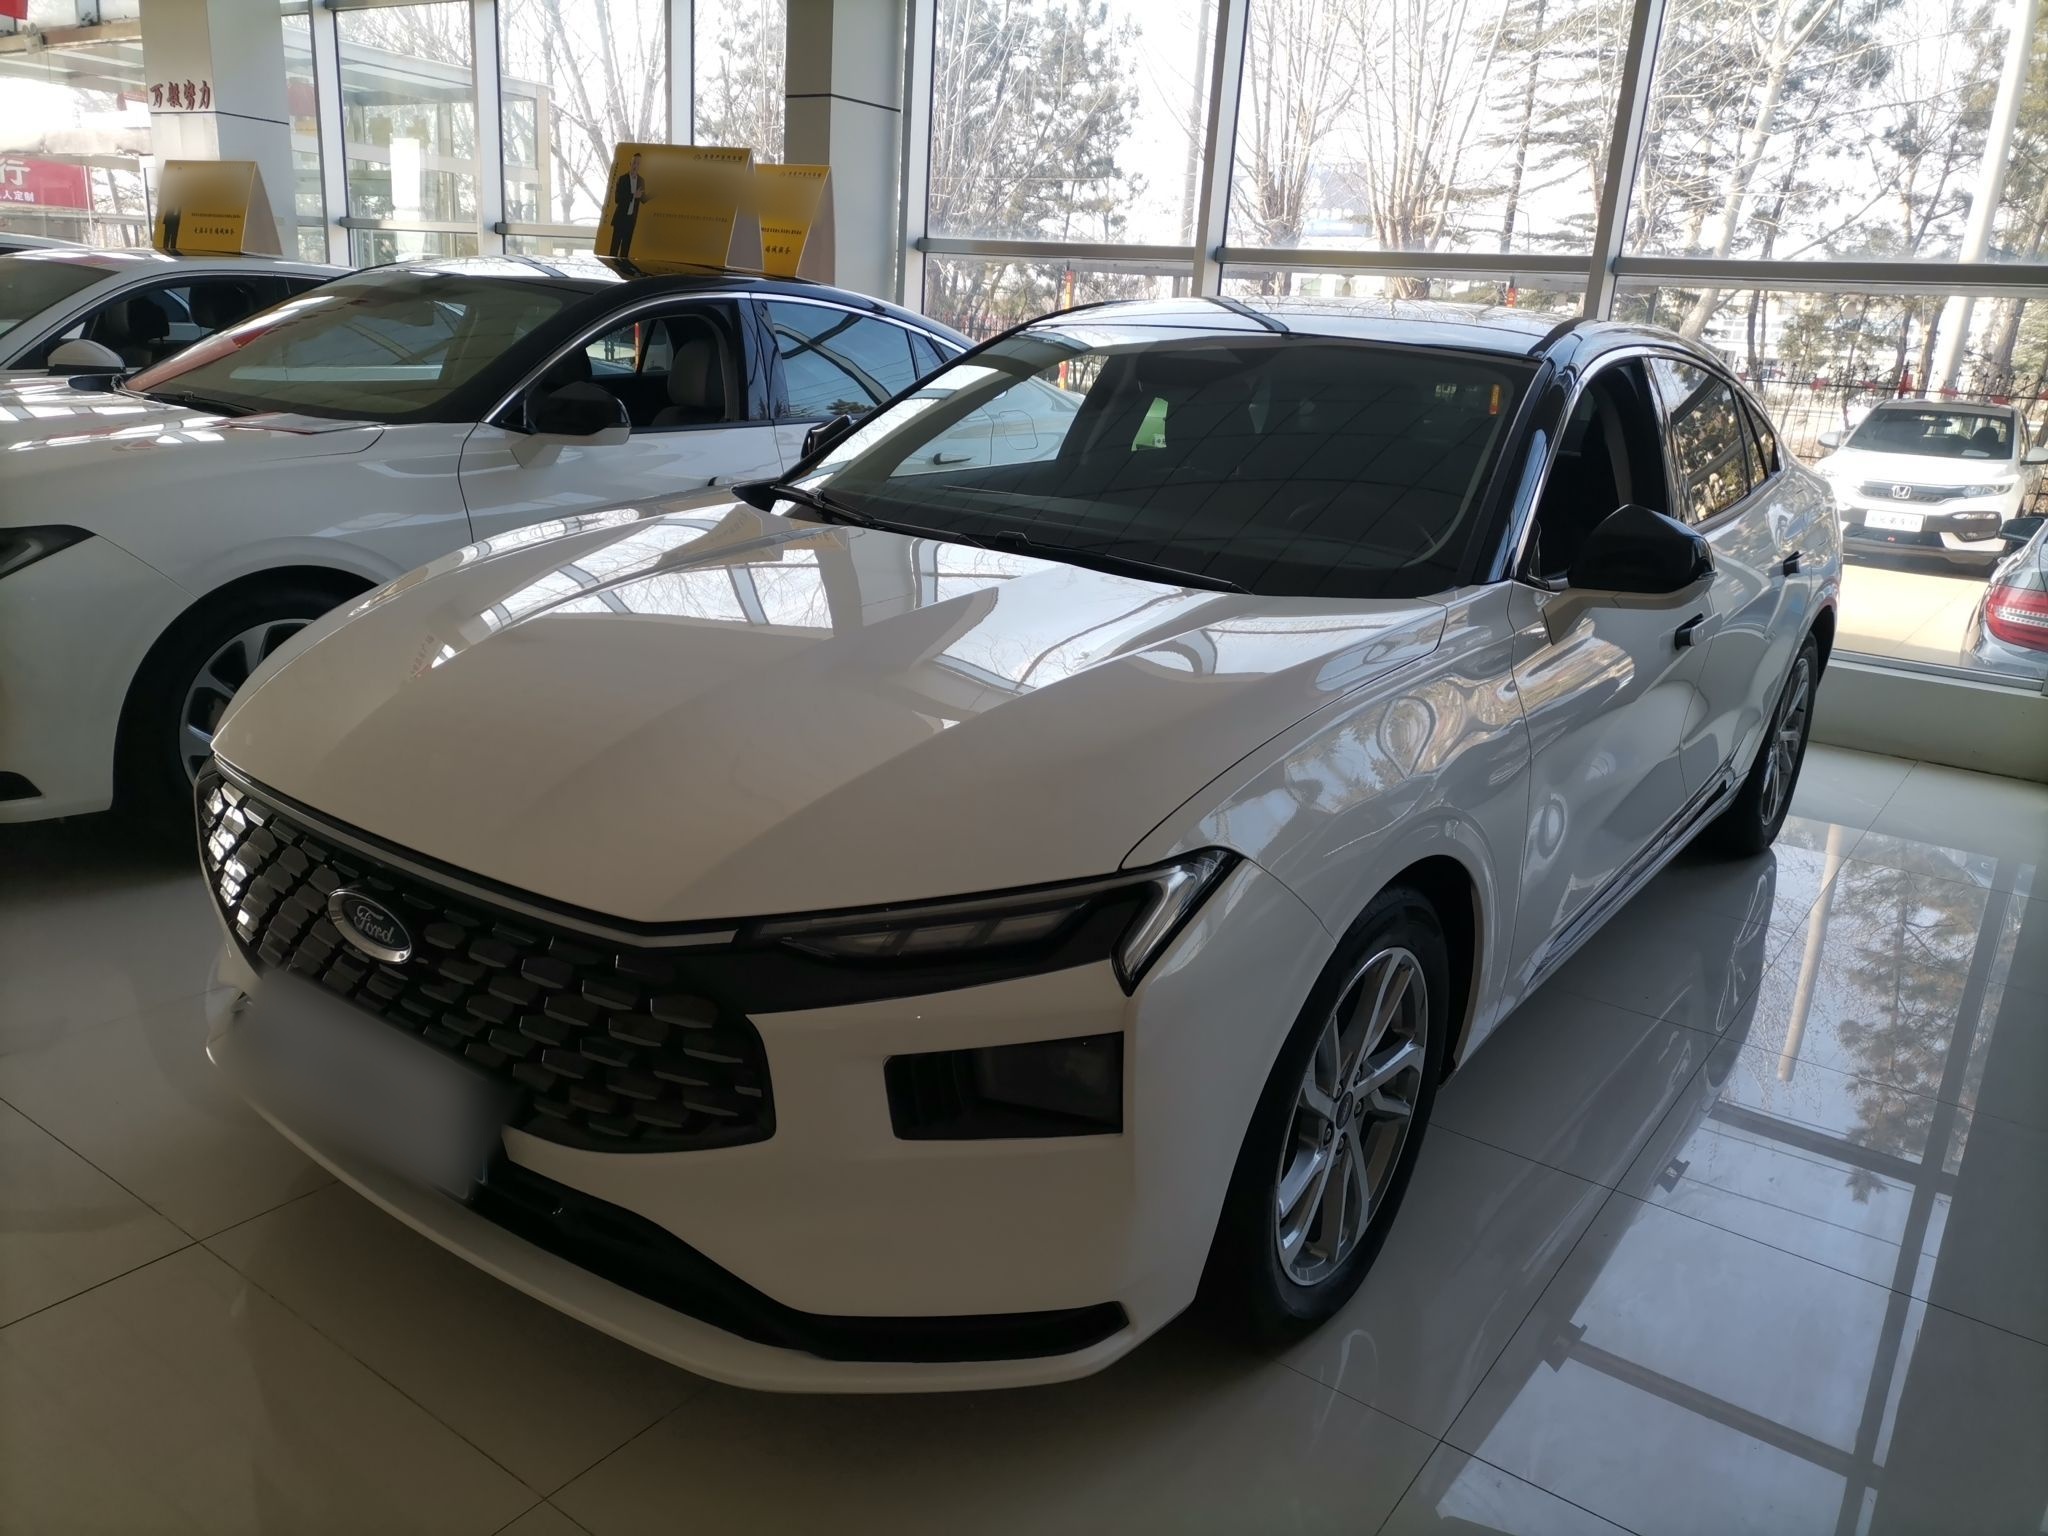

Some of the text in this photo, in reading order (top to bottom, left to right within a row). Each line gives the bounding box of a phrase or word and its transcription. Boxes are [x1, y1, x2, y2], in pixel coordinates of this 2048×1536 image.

[0, 189, 35, 203] 人定制
[353, 905, 395, 944] Ford
